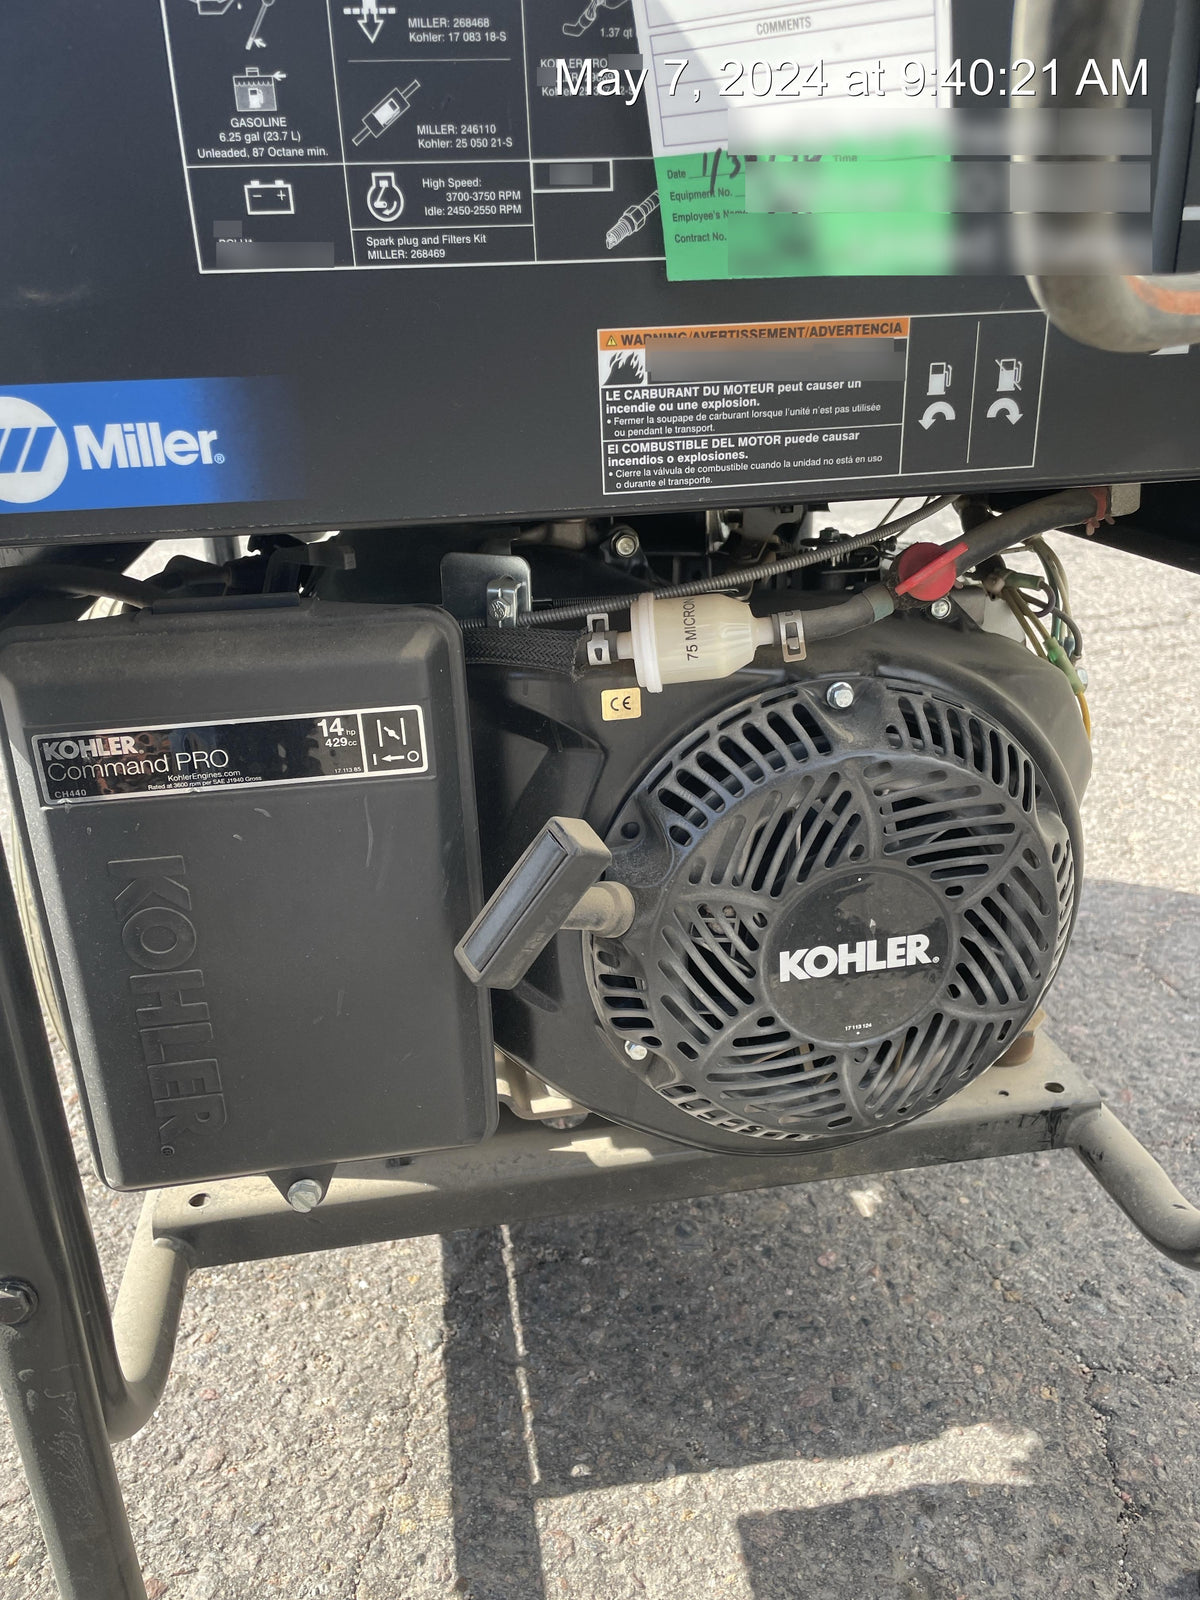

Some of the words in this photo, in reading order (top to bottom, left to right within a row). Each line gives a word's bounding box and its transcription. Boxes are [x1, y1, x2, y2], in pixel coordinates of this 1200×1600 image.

[408, 18, 450, 28] MILLER:
[453, 18, 490, 28] 268468
[756, 16, 812, 36] COMMENTS
[409, 32, 445, 42] Kohler:
[448, 32, 460, 42] 17
[463, 32, 481, 41] 083
[485, 32, 506, 41] 18-S
[600, 28, 620, 37] 1.37
[623, 28, 632, 39] qt
[230, 117, 287, 128] GASOLINE
[417, 125, 458, 135] MILLER:
[461, 124, 496, 134] 246110
[219, 132, 241, 142] 6.25
[244, 132, 259, 144] gal
[263, 131, 288, 143] (23.7
[291, 131, 301, 142] L)
[418, 139, 452, 148] Kohler:
[456, 139, 467, 148] 25
[470, 138, 488, 148] 050
[491, 137, 513, 147] 21-S
[197, 148, 250, 158] Unleaded,
[252, 148, 264, 157] 87
[268, 147, 304, 157] Octane
[307, 147, 329, 156] min.
[667, 170, 686, 179] Date
[422, 178, 445, 190] High
[448, 178, 482, 189] Speed:
[446, 192, 495, 201] 3700-3750
[499, 190, 521, 200] RPM
[718, 188, 732, 197] No.
[425, 206, 445, 216] Idle:
[447, 206, 496, 215] 2450-2550
[500, 205, 522, 214] RPM
[672, 210, 720, 223] Employee's
[366, 236, 395, 248] Spark
[398, 236, 418, 247] plug
[421, 235, 439, 245] and
[442, 235, 471, 244] Filters
[474, 234, 487, 243] Kit
[674, 233, 710, 243] Contract
[712, 231, 727, 241] No.
[368, 250, 408, 259] MILLER:
[411, 249, 445, 258] 268469
[606, 390, 620, 401] LE
[624, 387, 699, 400] CARBURANT
[703, 386, 720, 396] DU
[724, 383, 774, 395] MOTEUR
[778, 382, 803, 394] peut
[806, 381, 844, 390] causer
[848, 380, 861, 388] un
[606, 402, 656, 414] incendie
[660, 402, 674, 411] ou
[677, 401, 698, 410] une
[702, 398, 760, 411] explosion.
[614, 416, 644, 426] Fermer
[647, 416, 654, 424] la
[657, 414, 693, 424] soupape
[709, 410, 749, 420] carburant
[752, 409, 782, 419] lorsque
[812, 406, 832, 414] n'est
[835, 405, 849, 414] pas
[852, 403, 881, 412] utilisée
[628, 426, 662, 438] pendant
[665, 426, 672, 434] le
[675, 424, 715, 434] transport.
[622, 439, 708, 454] COMBUSTIBLE
[712, 438, 734, 448] DEL
[738, 435, 781, 446] MOTOR
[784, 433, 819, 446] puede
[822, 432, 860, 442] causar
[608, 455, 663, 466] incendios
[678, 450, 748, 465] explosiones.
[615, 468, 641, 478] Cierre
[653, 467, 682, 476] válvula
[685, 465, 695, 473] de
[698, 462, 748, 472] combustible
[751, 460, 781, 470] cuando
[784, 460, 790, 468] la
[793, 458, 821, 467] unidad
[836, 456, 853, 464] está
[624, 478, 656, 488] durante
[658, 478, 666, 486] el
[668, 476, 712, 486] transporte.
[686, 644, 699, 661] 75
[610, 695, 632, 711] CE
[317, 717, 344, 737] 14
[47, 754, 169, 782] Command
[175, 749, 229, 771] PRO
[168, 770, 240, 782] KohlerEngines.com
[55, 789, 87, 798] CH440
